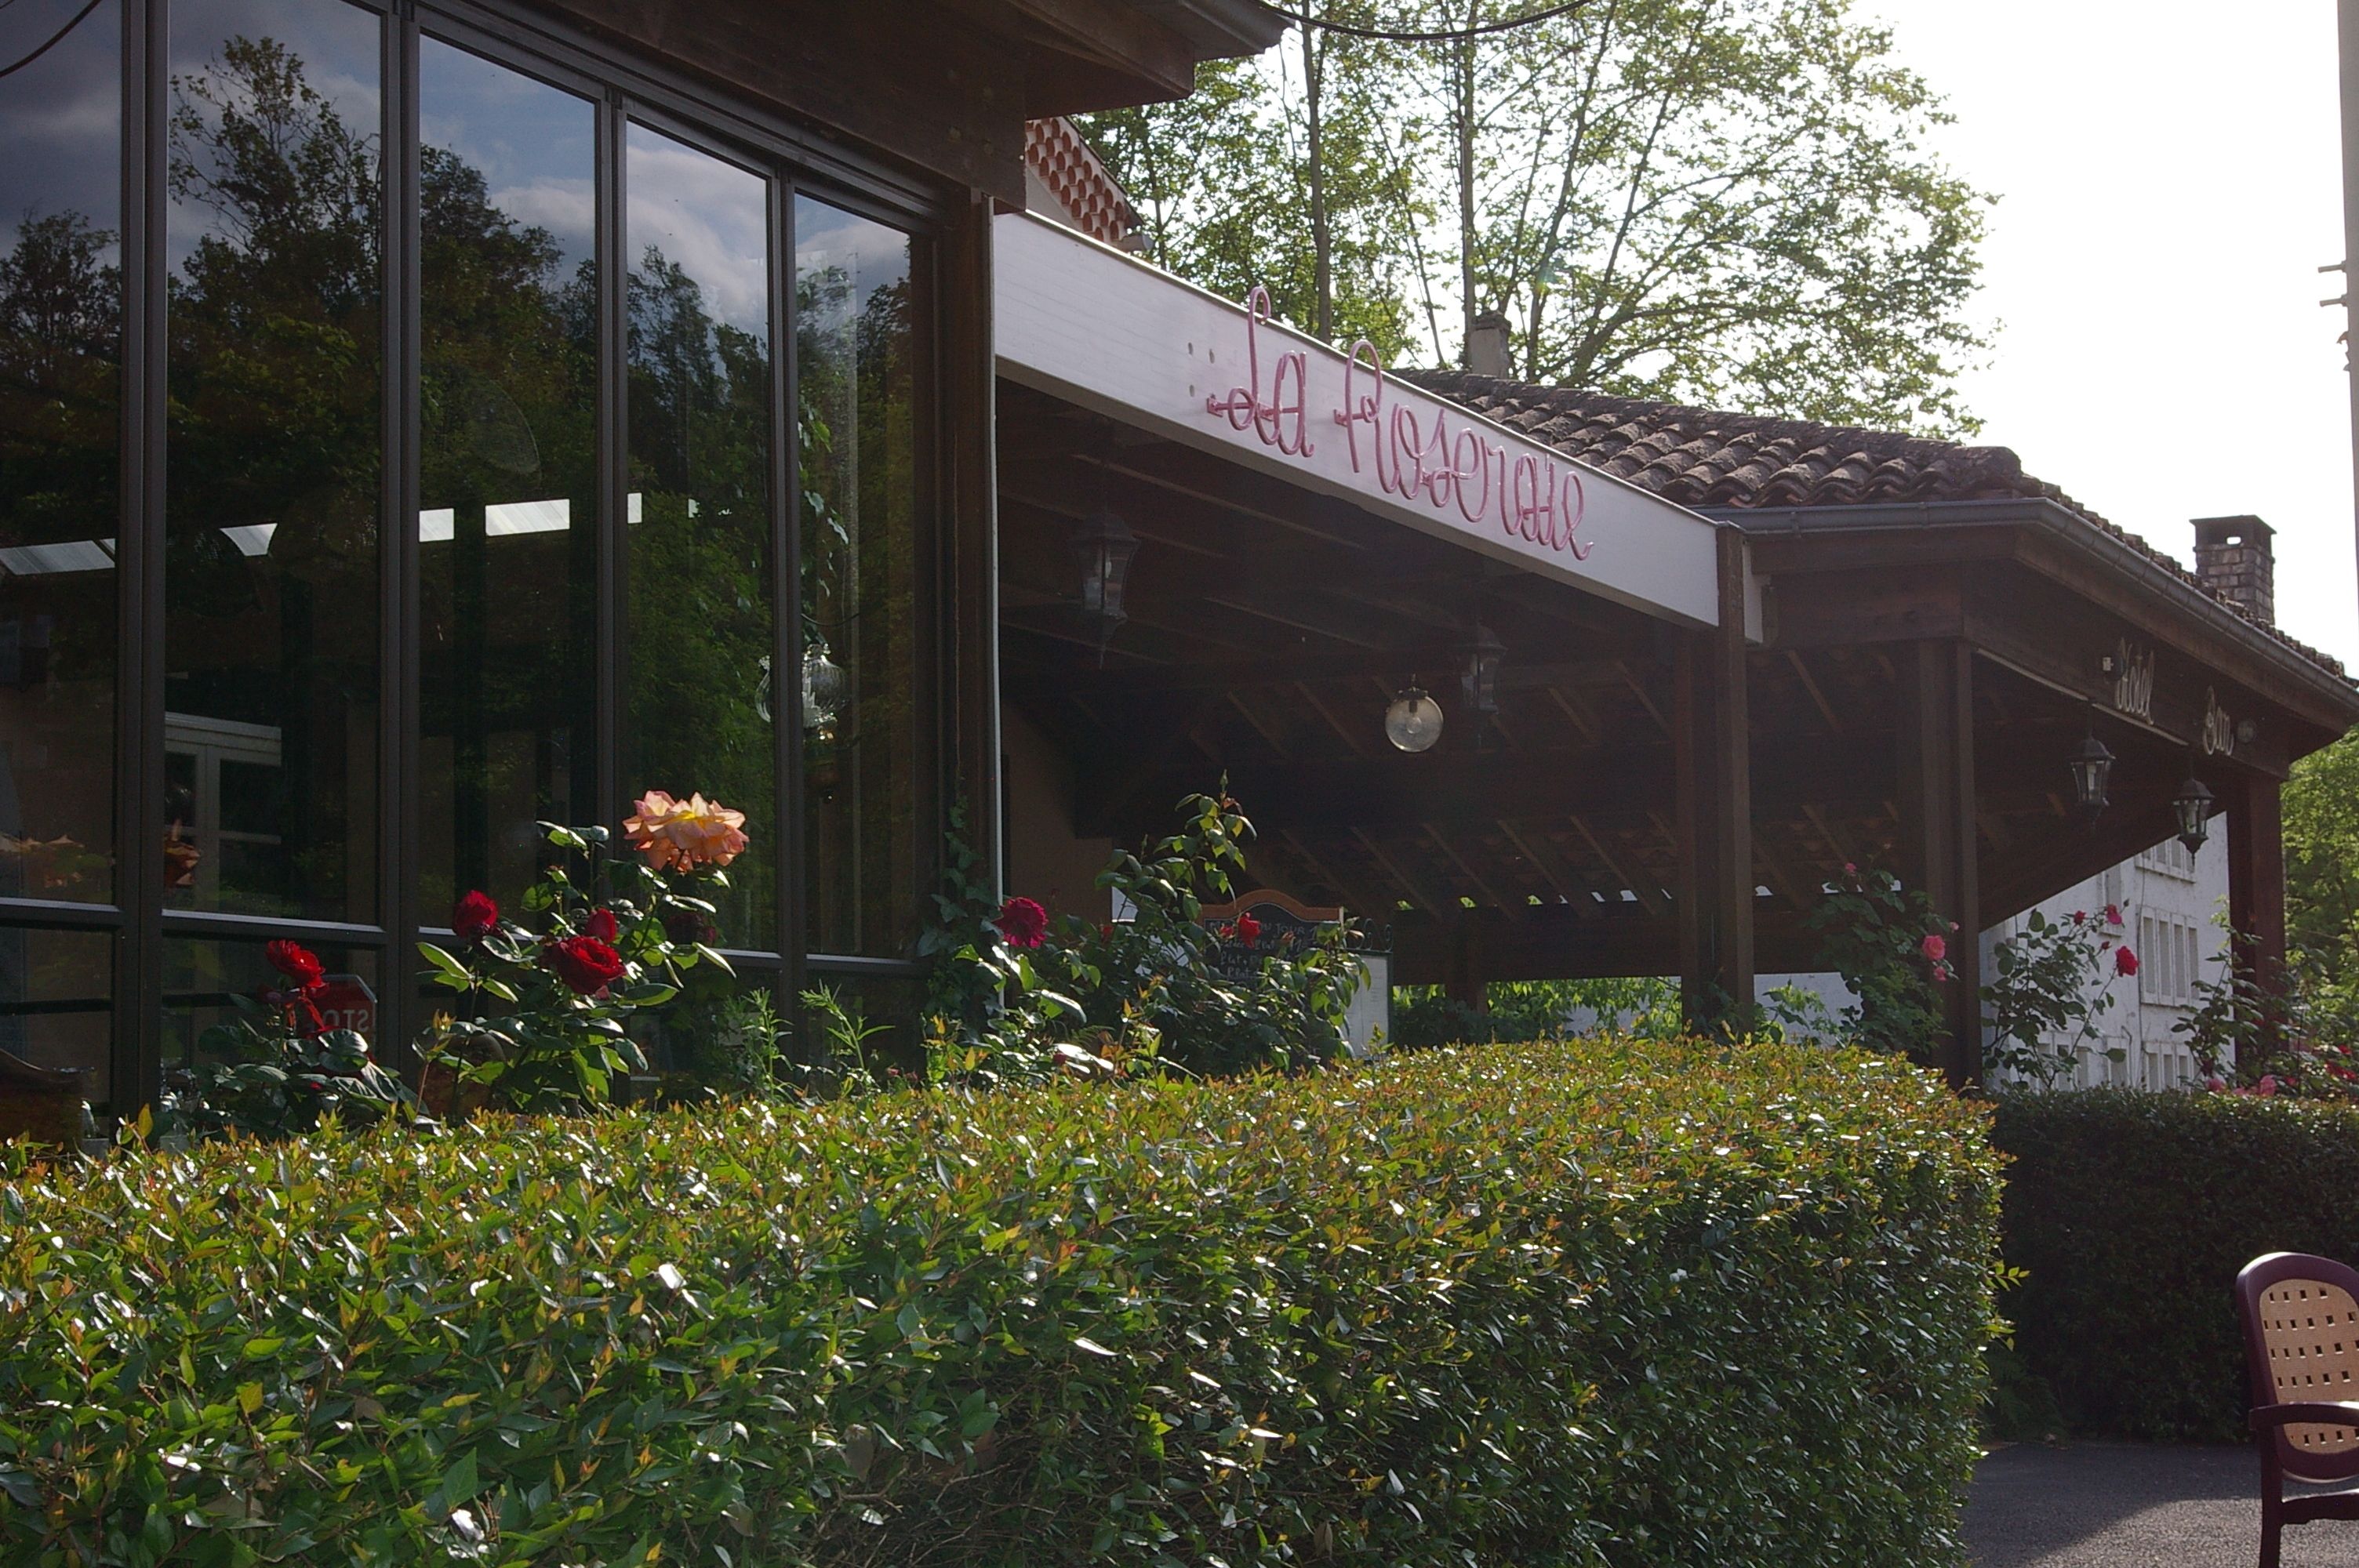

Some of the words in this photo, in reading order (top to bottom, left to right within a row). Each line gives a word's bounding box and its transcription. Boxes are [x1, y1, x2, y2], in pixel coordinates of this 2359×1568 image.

[1227, 285, 1315, 458] La
[1344, 339, 1595, 561] Roseraie
[2202, 684, 2235, 756] Bar
